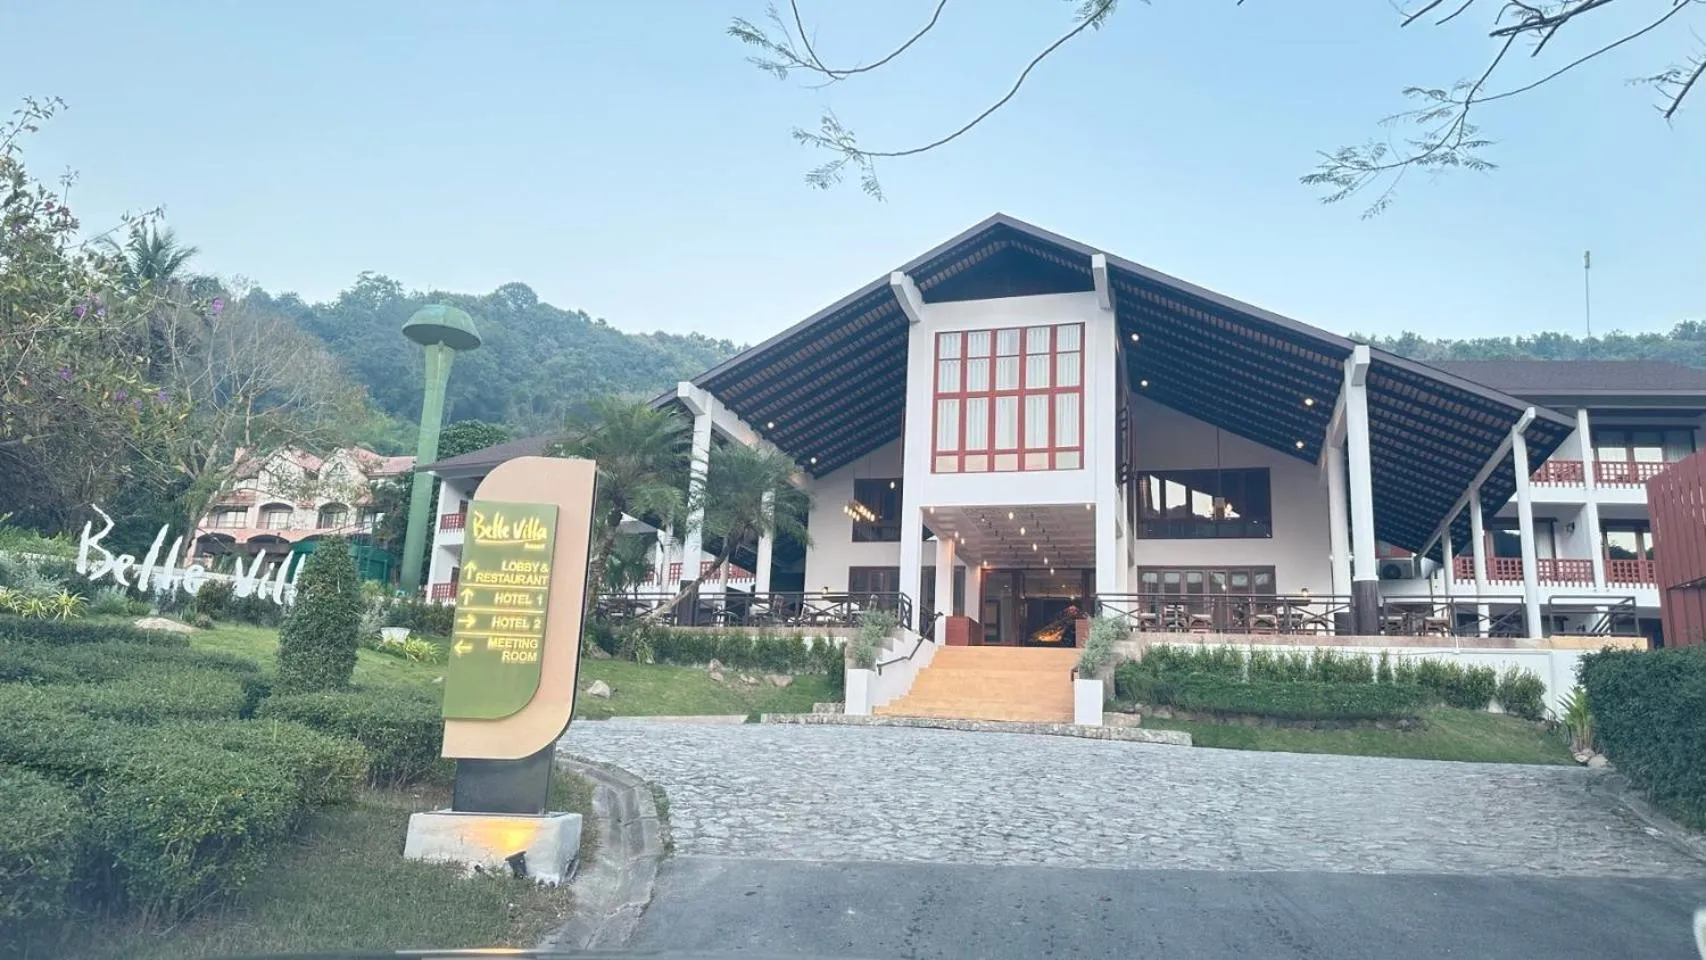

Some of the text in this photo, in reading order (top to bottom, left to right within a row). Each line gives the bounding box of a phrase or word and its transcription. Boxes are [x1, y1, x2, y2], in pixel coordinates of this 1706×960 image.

[473, 510, 547, 541] Belle Villa
[76, 503, 204, 595] Belle
[501, 560, 549, 573] LOBBY &
[475, 572, 549, 585] RESTAURANT
[494, 592, 542, 605] HOTEL 1
[491, 616, 542, 629] HOTEL 2
[487, 637, 538, 650] MEETING
[501, 650, 538, 663] ROOM
